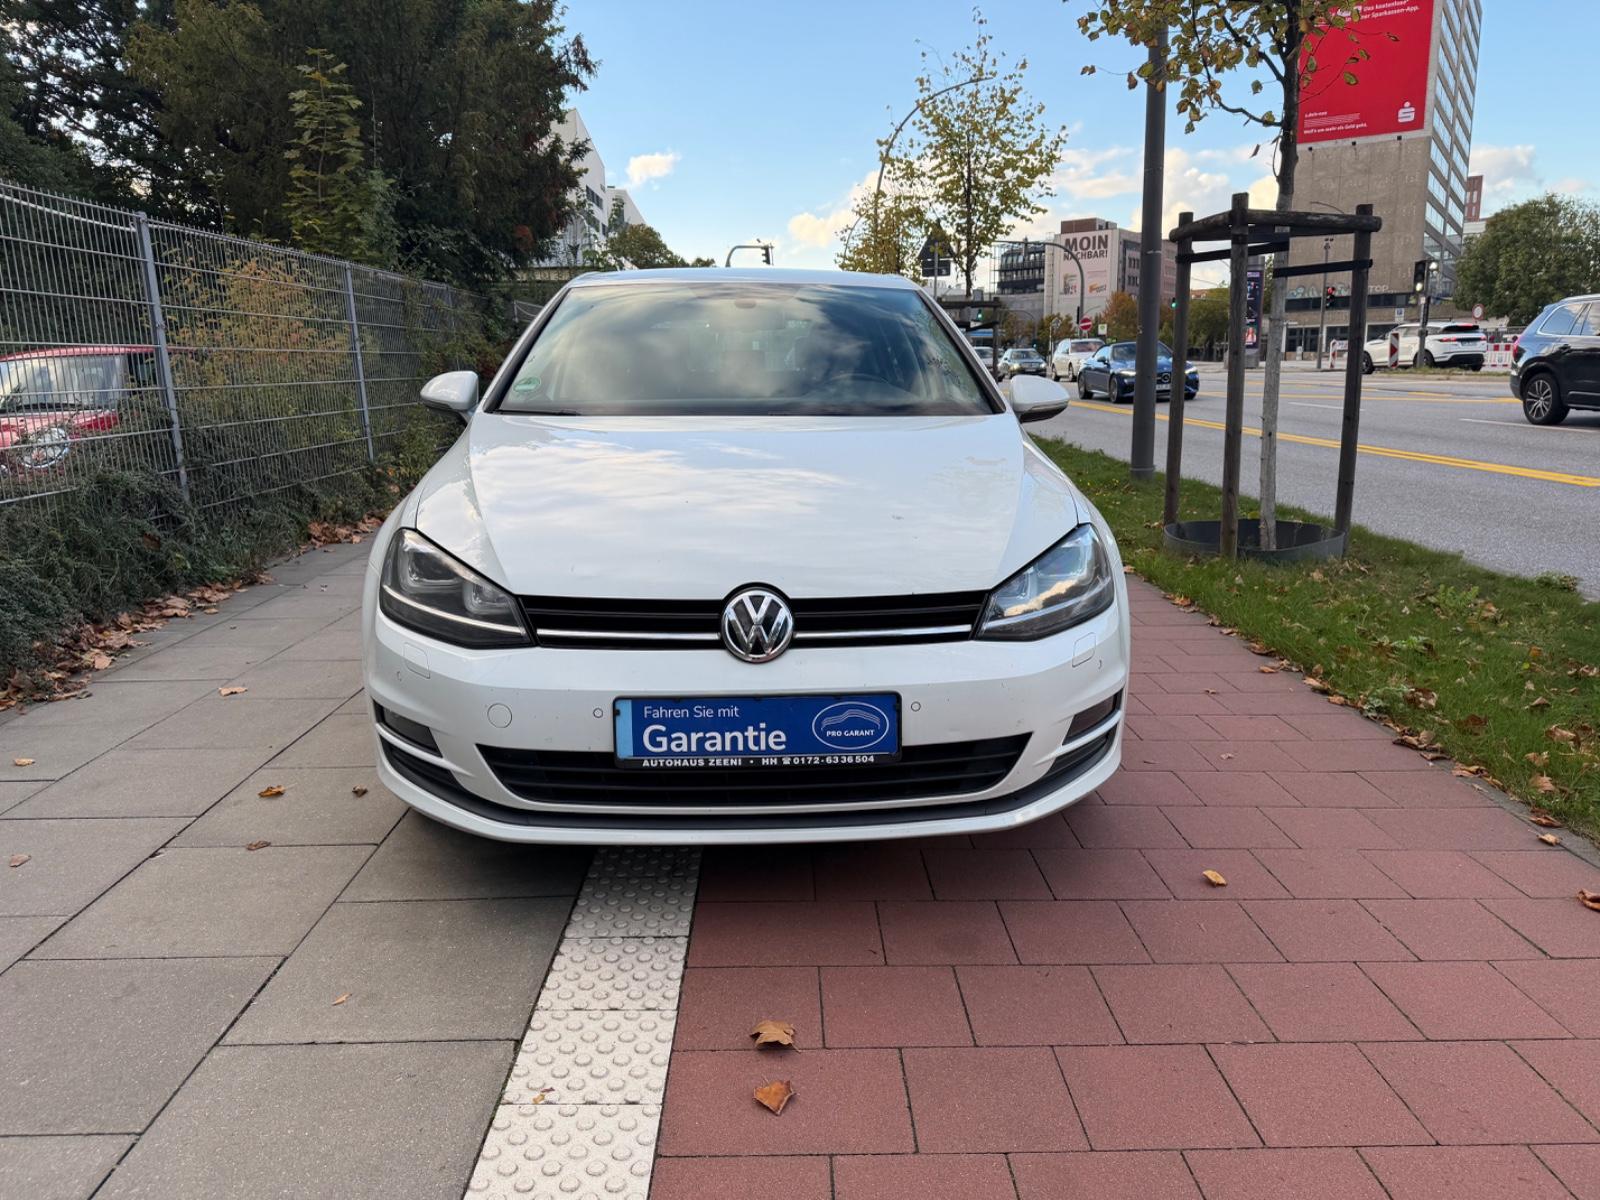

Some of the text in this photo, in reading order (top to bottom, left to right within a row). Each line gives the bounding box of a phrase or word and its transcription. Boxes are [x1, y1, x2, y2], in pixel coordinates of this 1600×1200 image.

[1064, 234, 1108, 252] MOIN
[643, 704, 740, 719] Fahren Sie mit
[642, 722, 787, 753] Garantie
[844, 729, 875, 737] GARANT
[642, 758, 705, 767] AUTOHAUS
[708, 757, 742, 767] ZEENI
